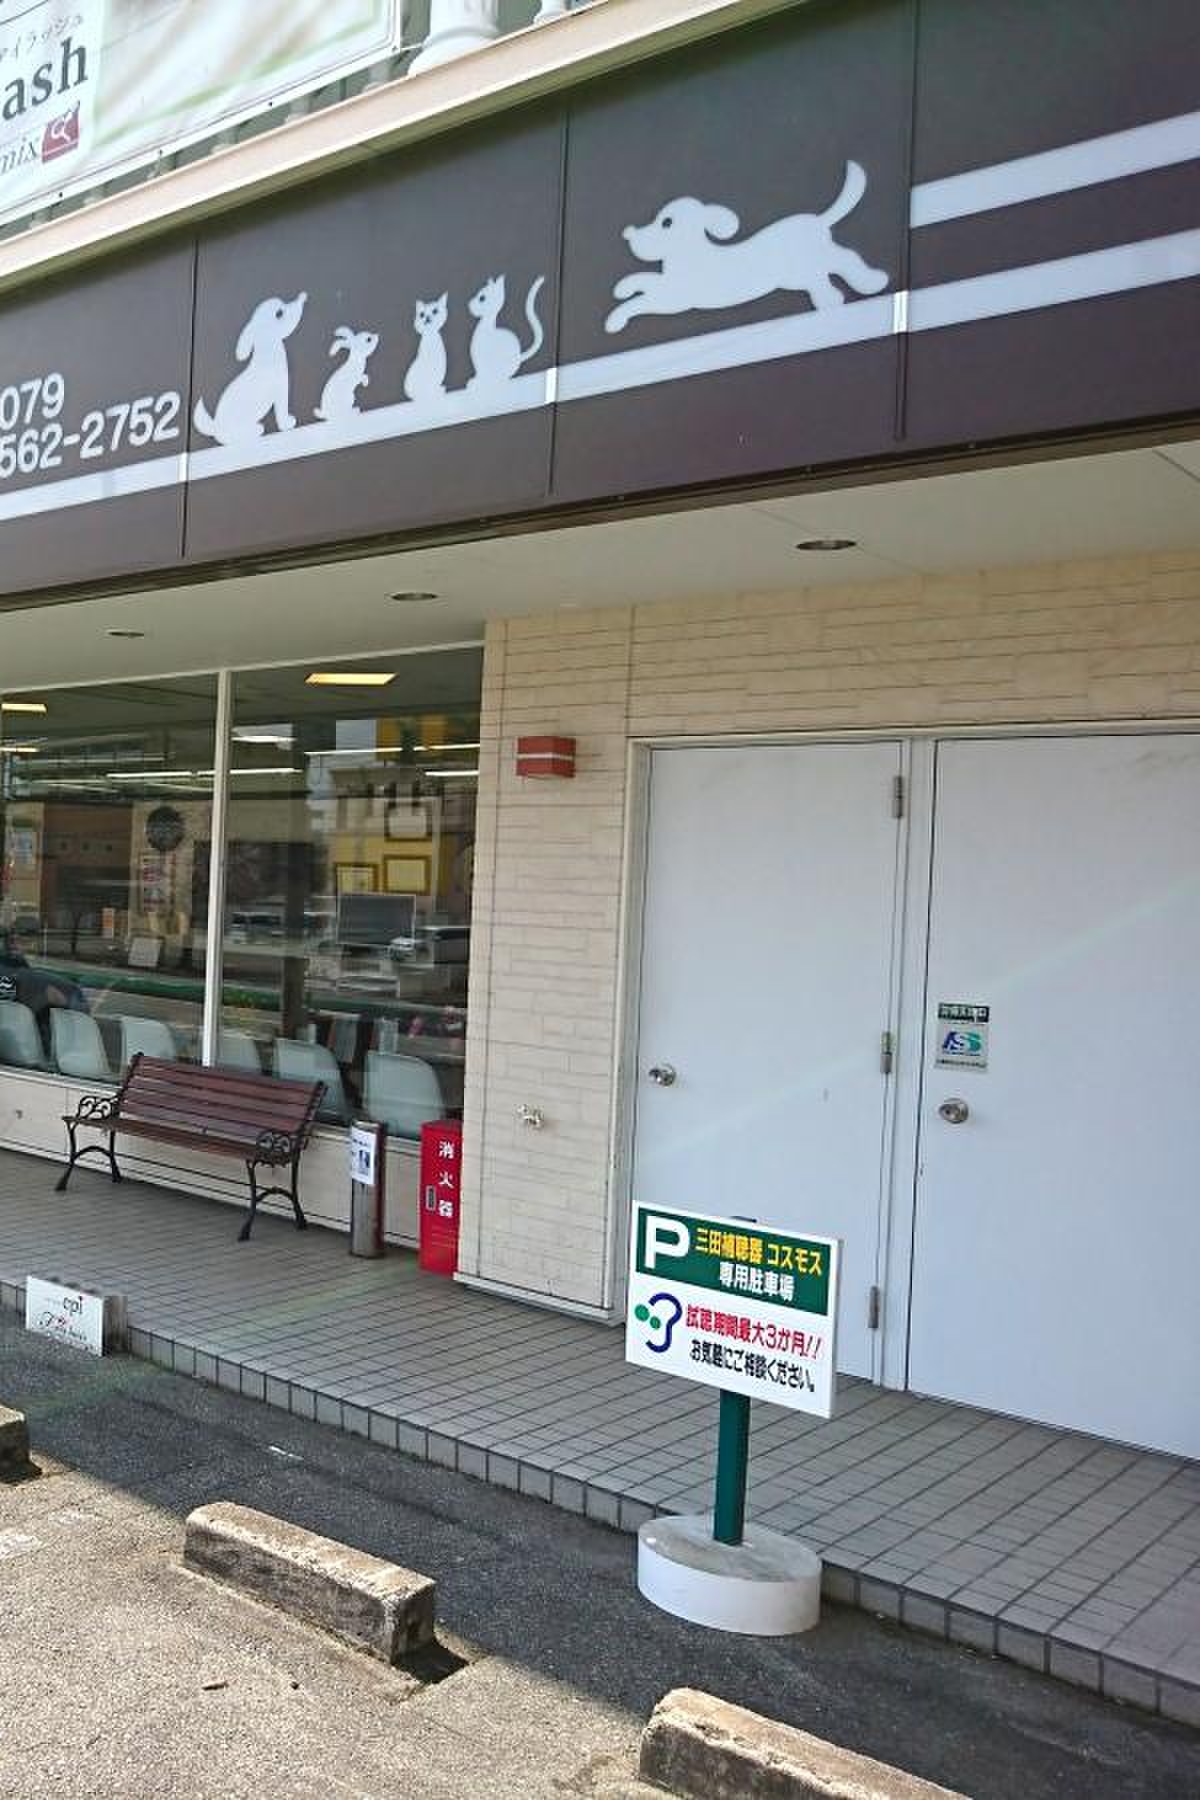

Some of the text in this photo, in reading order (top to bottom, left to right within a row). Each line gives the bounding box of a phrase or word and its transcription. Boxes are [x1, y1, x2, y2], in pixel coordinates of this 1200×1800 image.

[438, 1140, 455, 1219] 消火器
[644, 1215, 690, 1269] P
[767, 1242, 823, 1276] コスモス
[719, 1260, 795, 1302] 専用駐車場
